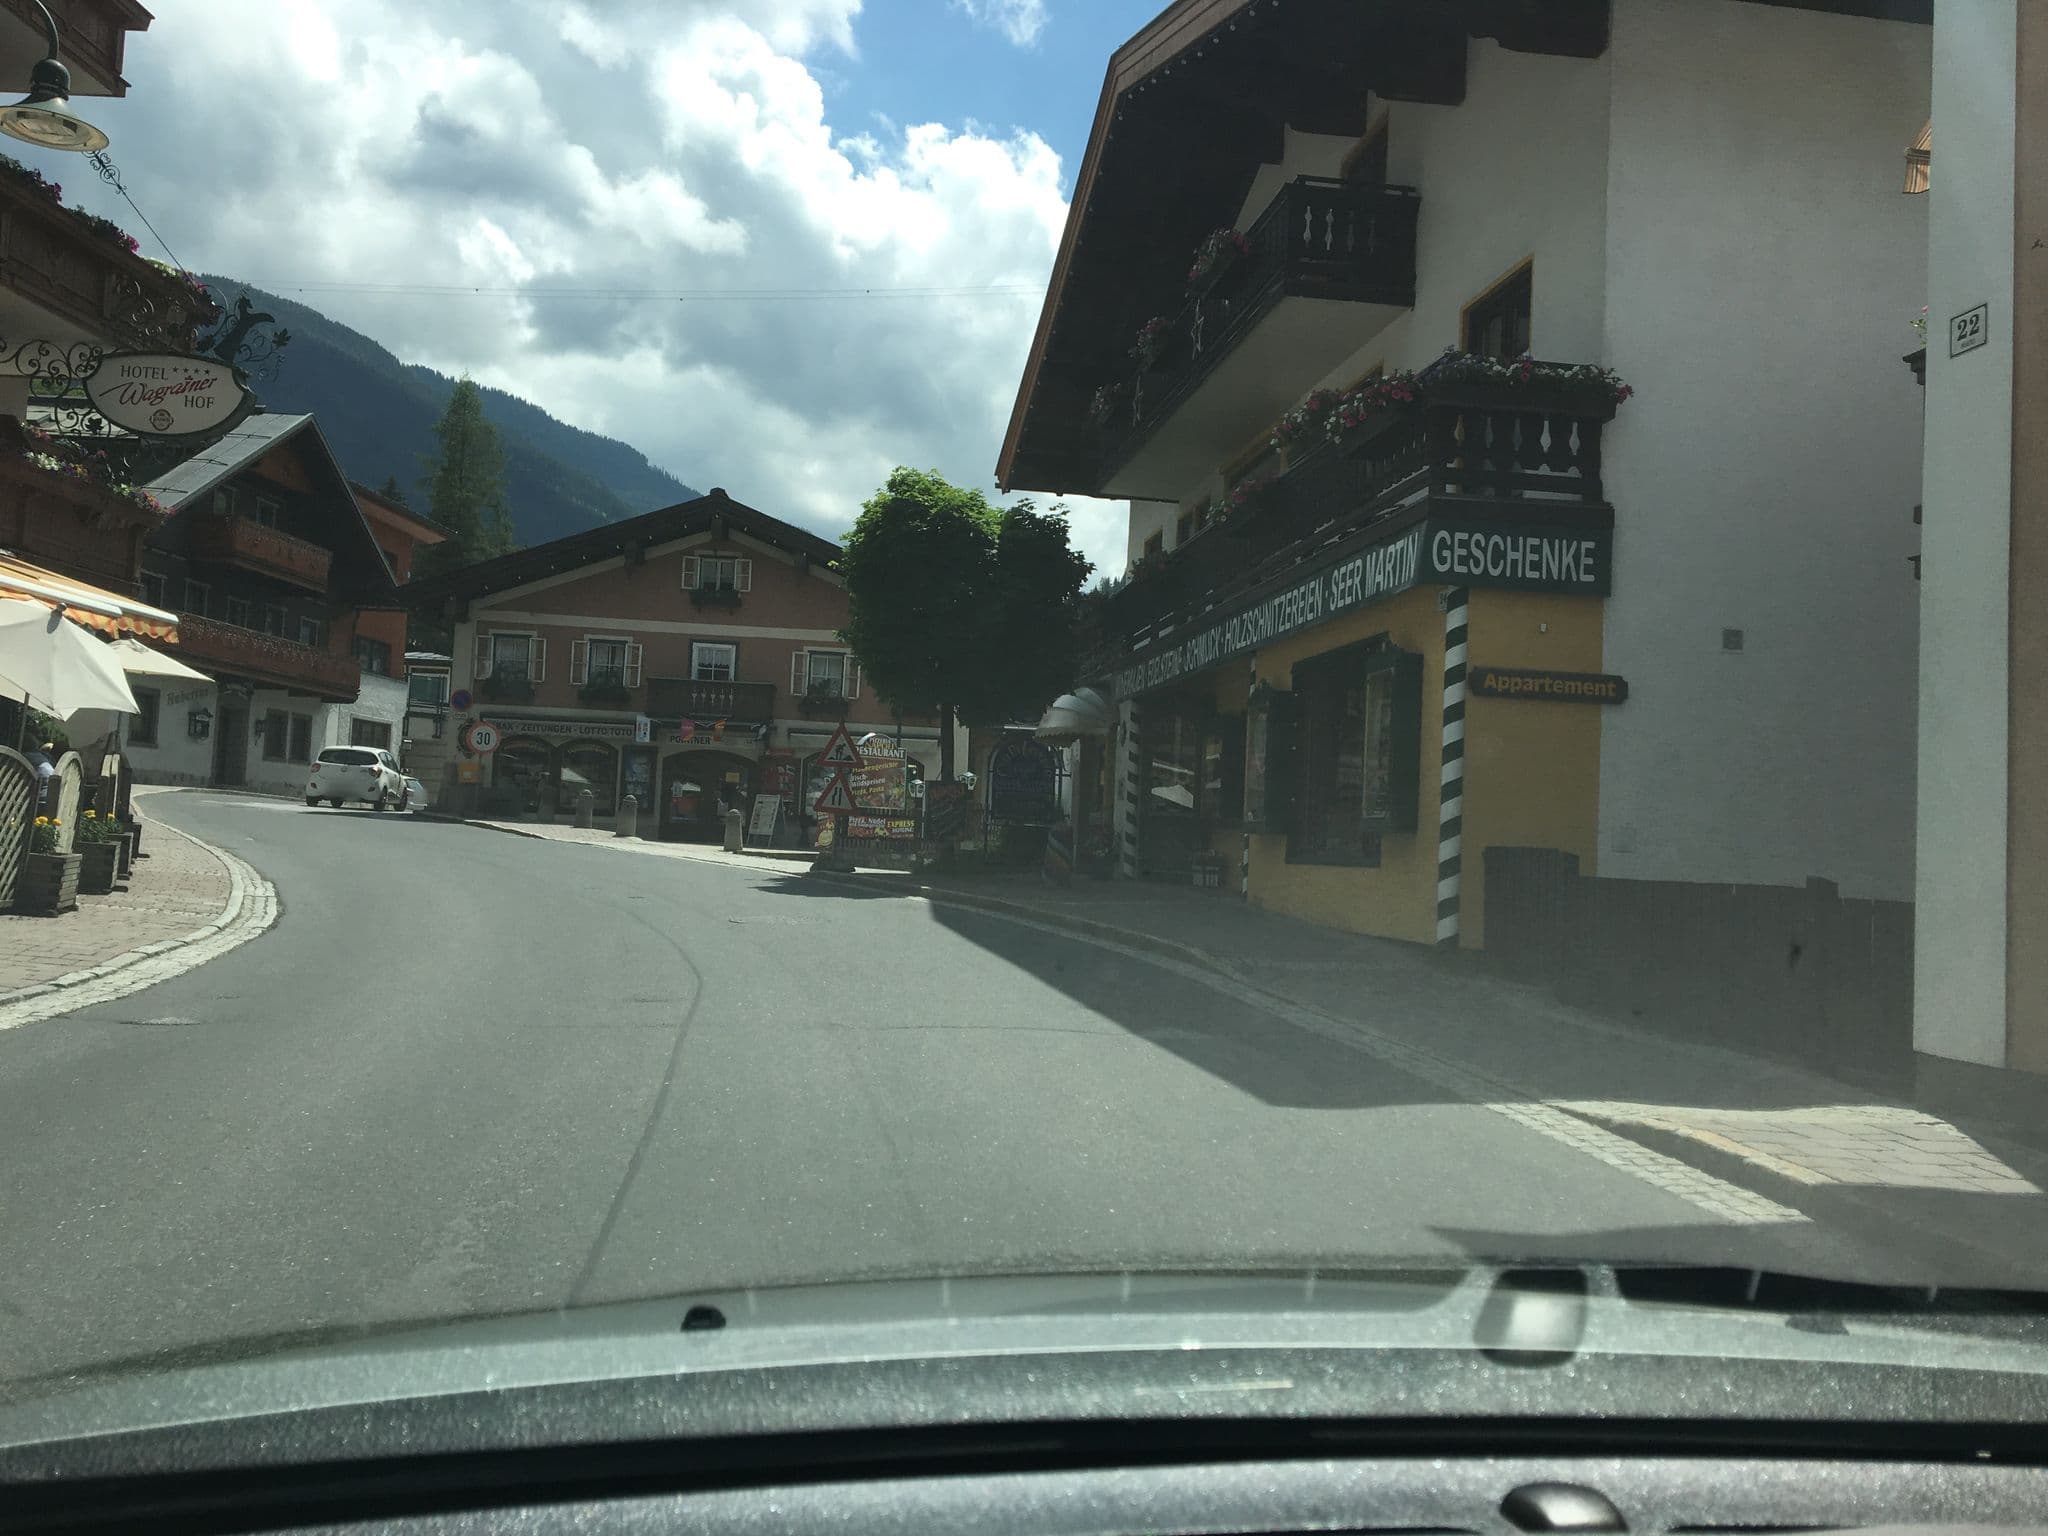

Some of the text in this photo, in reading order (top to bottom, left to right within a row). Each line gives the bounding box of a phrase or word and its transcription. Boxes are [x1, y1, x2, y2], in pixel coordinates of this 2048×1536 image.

[1957, 314, 1980, 341] 22
[120, 364, 168, 380] HOTEL
[98, 375, 218, 407] Wagrainer
[184, 395, 216, 409] HOF
[1431, 529, 1596, 583] GESCHENKE
[1184, 625, 1222, 673] SCHMUCK
[1224, 576, 1323, 655] HOLZSCHNITZEREIEN
[1328, 558, 1362, 612] SEER
[1364, 532, 1419, 598] MARTIN
[1482, 672, 1617, 697] Appartement
[476, 732, 491, 746] 30
[521, 723, 573, 734] ZEITUNGEN
